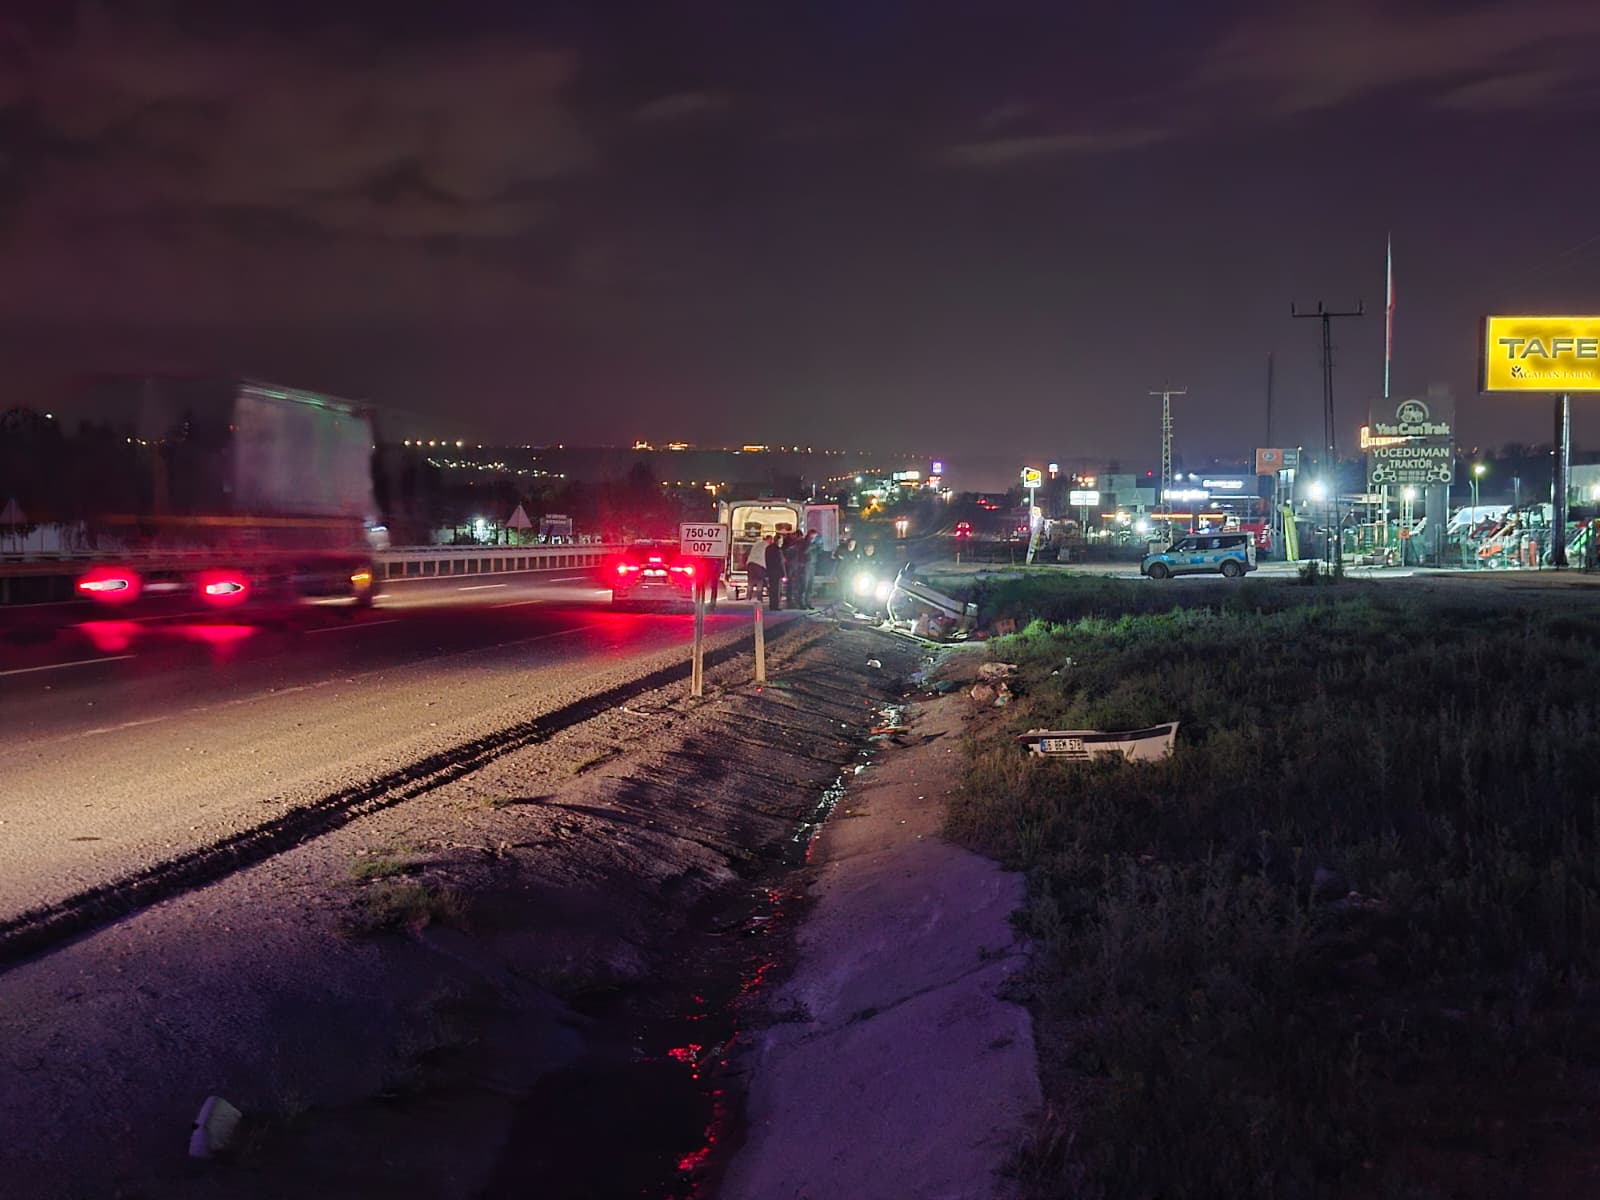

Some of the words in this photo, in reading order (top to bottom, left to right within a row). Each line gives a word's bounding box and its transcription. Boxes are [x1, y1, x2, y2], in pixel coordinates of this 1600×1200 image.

[1498, 338, 1599, 359] TAFE
[685, 528, 721, 538] 750-07
[693, 543, 713, 552] 007
